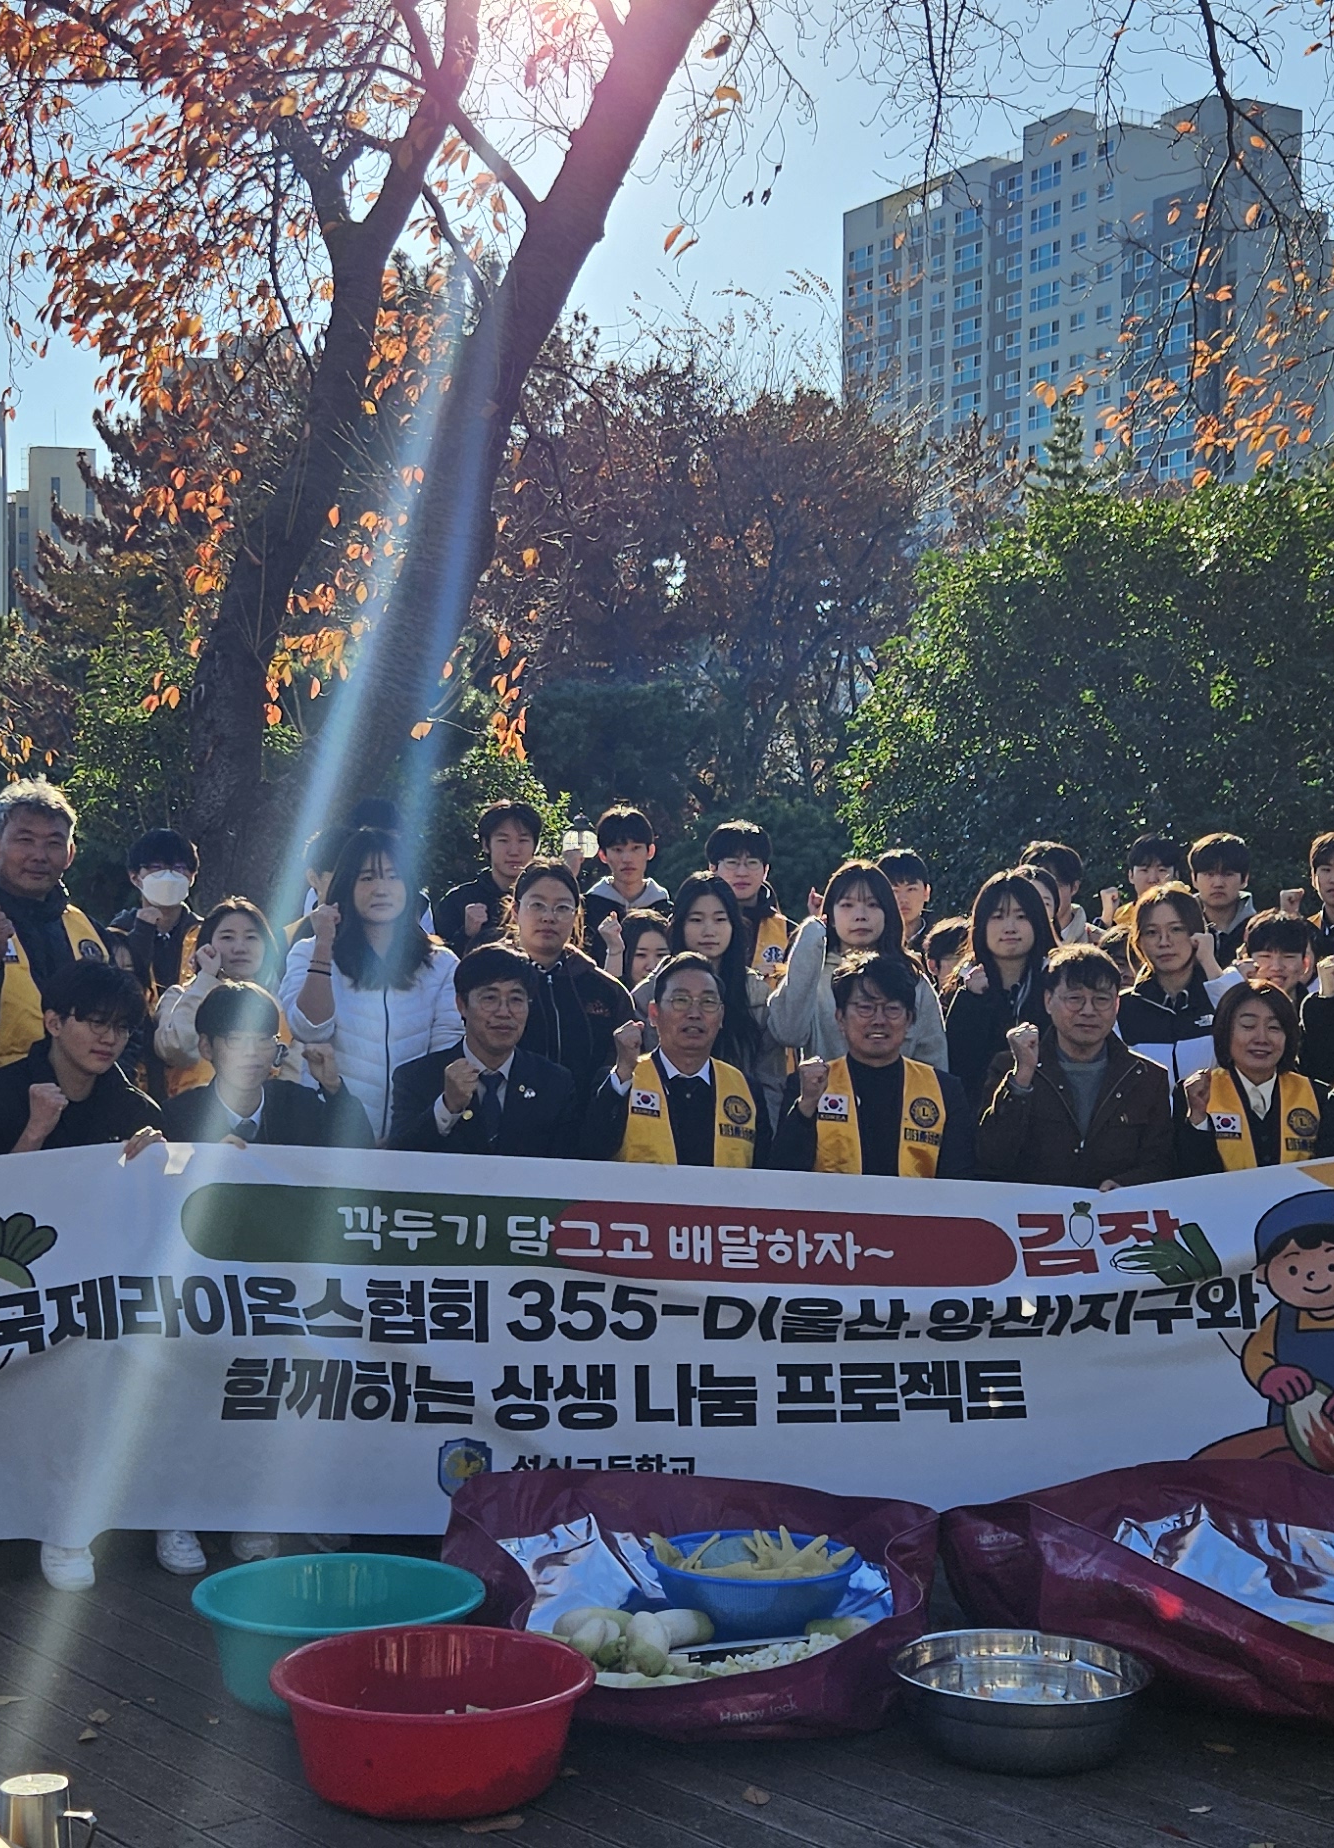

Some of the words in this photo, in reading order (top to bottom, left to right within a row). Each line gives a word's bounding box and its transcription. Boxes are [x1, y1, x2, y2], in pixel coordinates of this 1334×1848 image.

[337, 1205, 487, 1252] 깍두기
[506, 1214, 655, 1262] 담그고
[667, 1224, 895, 1272] 배달하자~
[1016, 1203, 1183, 1280] 김장
[220, 1357, 475, 1425] 함께하는
[490, 1362, 617, 1433] 상생
[633, 1363, 758, 1428] 나눔
[775, 1359, 1028, 1425] 프로젝트
[720, 1709, 765, 1722] Happy
